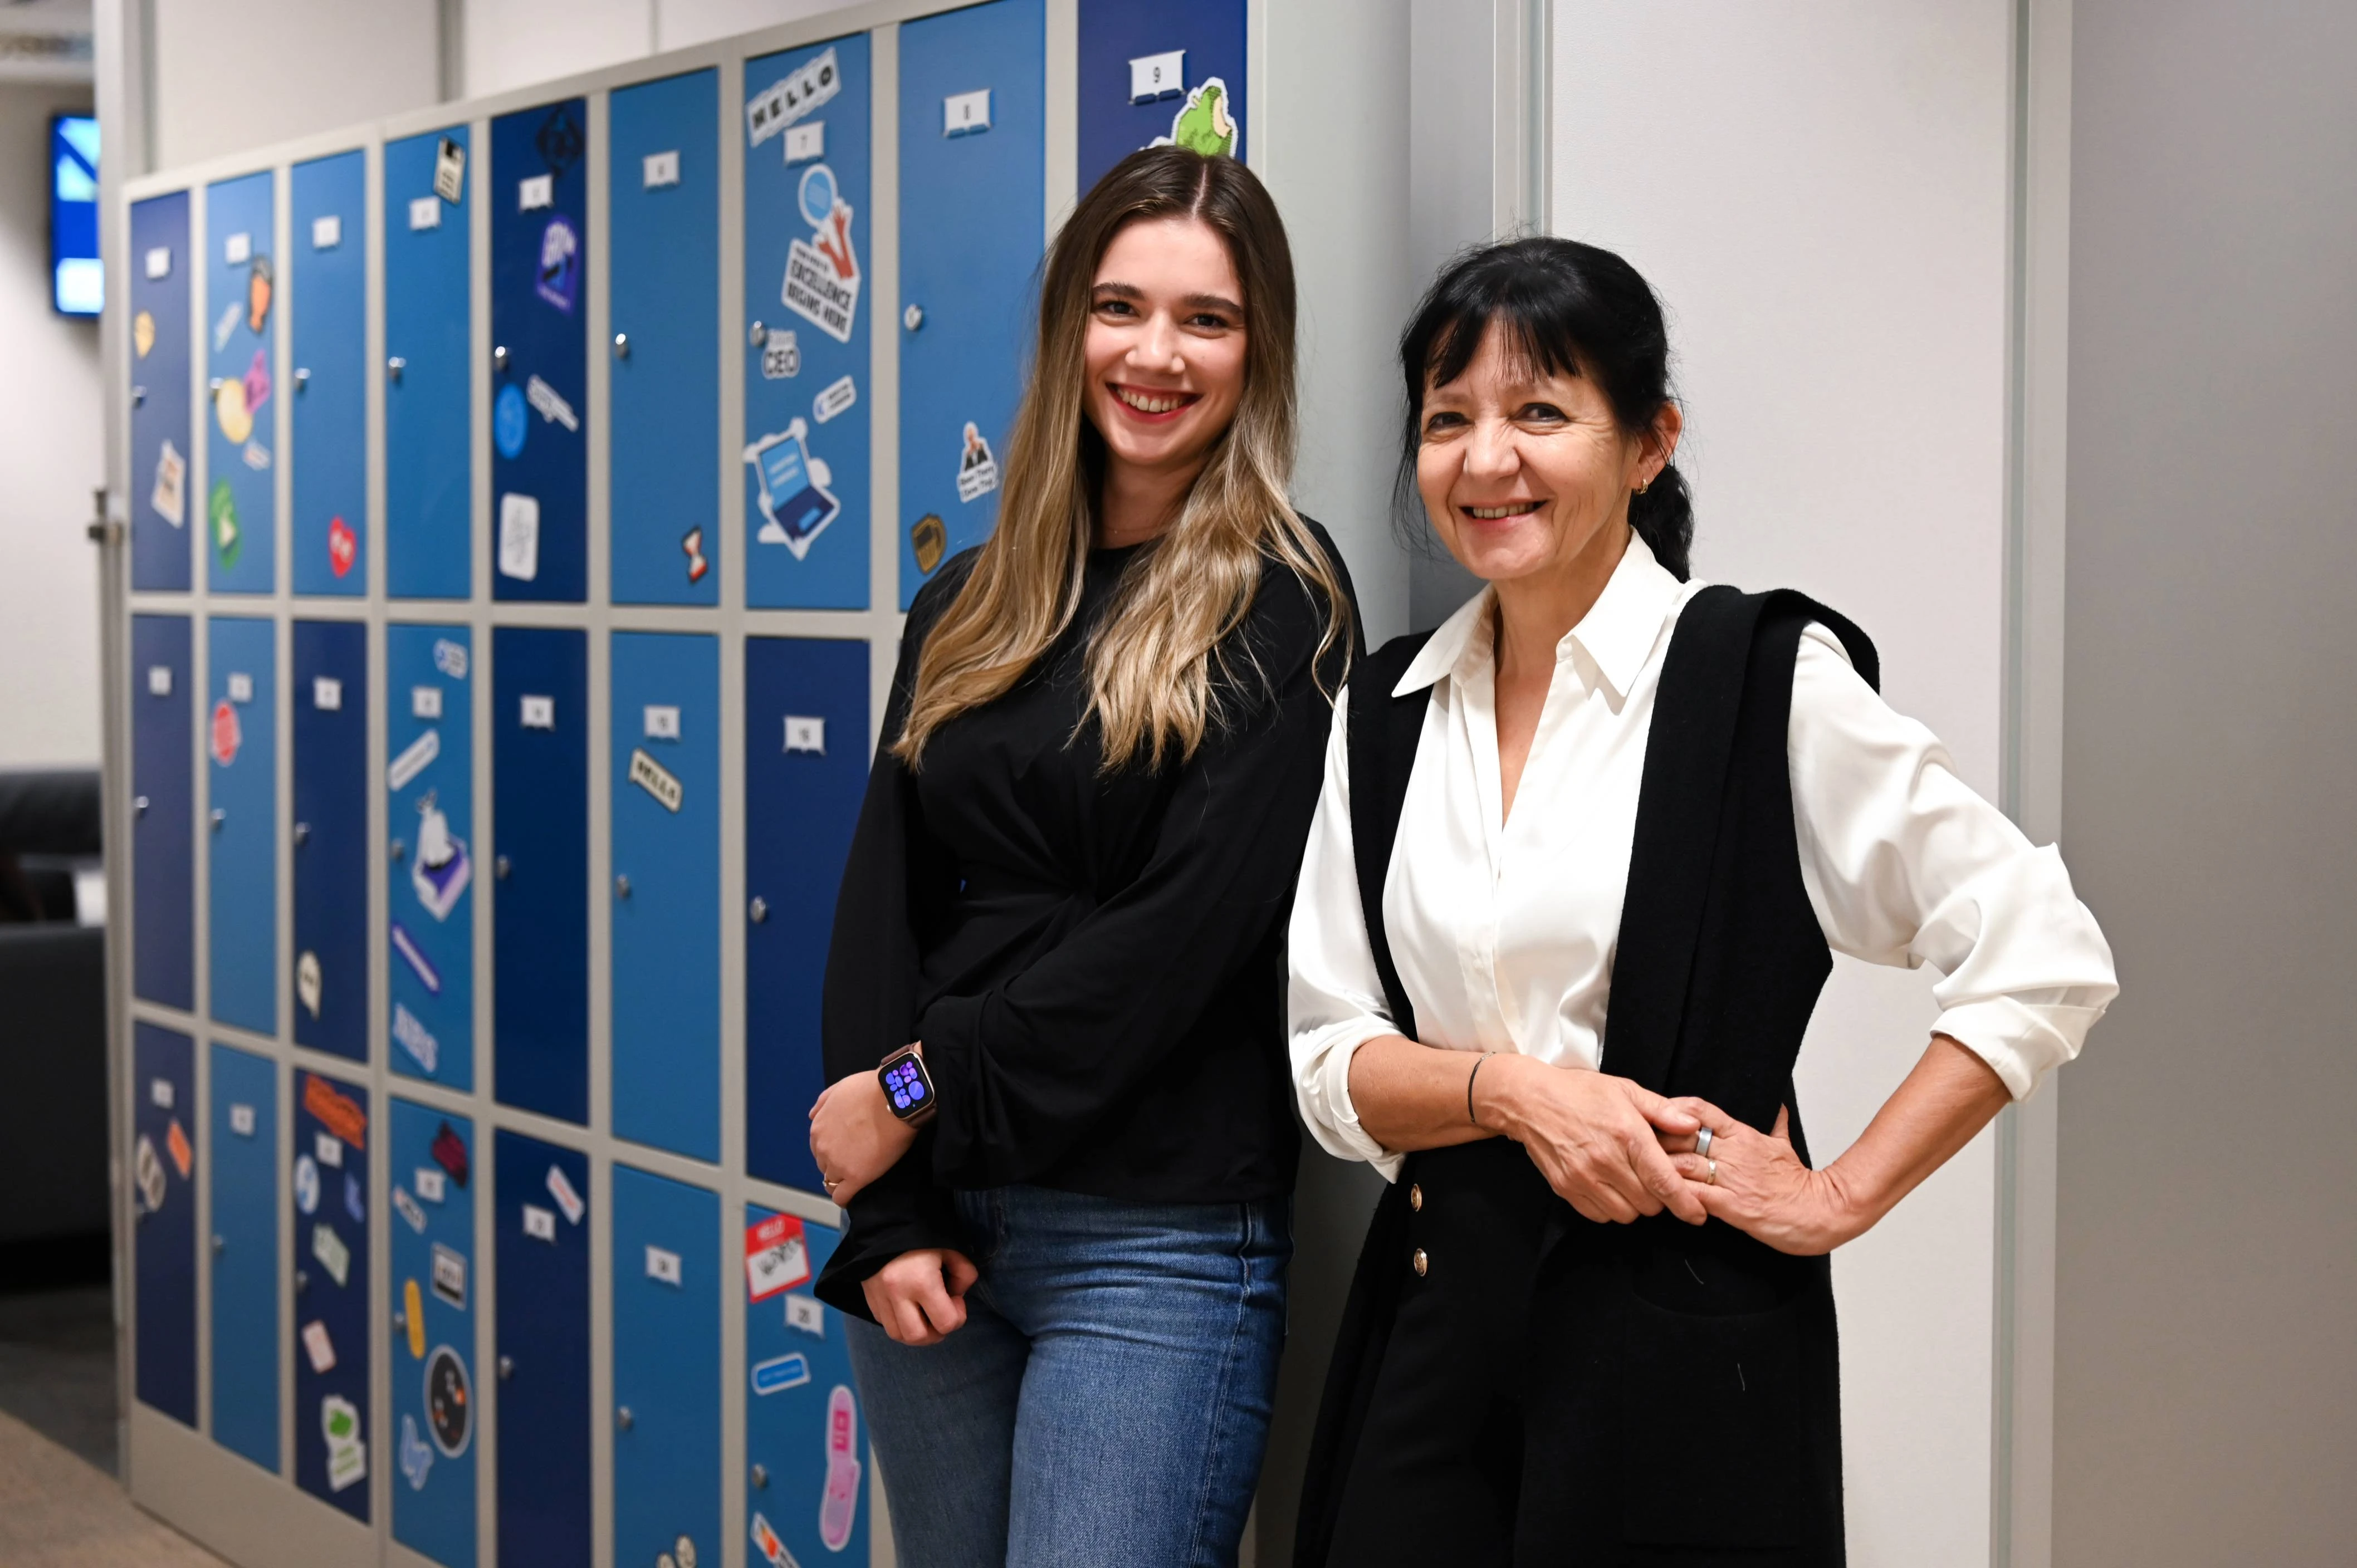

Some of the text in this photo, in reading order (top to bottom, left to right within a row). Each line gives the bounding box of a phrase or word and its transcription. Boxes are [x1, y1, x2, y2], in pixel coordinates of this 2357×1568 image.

[1153, 66, 1161, 84] 9
[752, 65, 833, 130] HELLO
[764, 349, 798, 375] CEO
